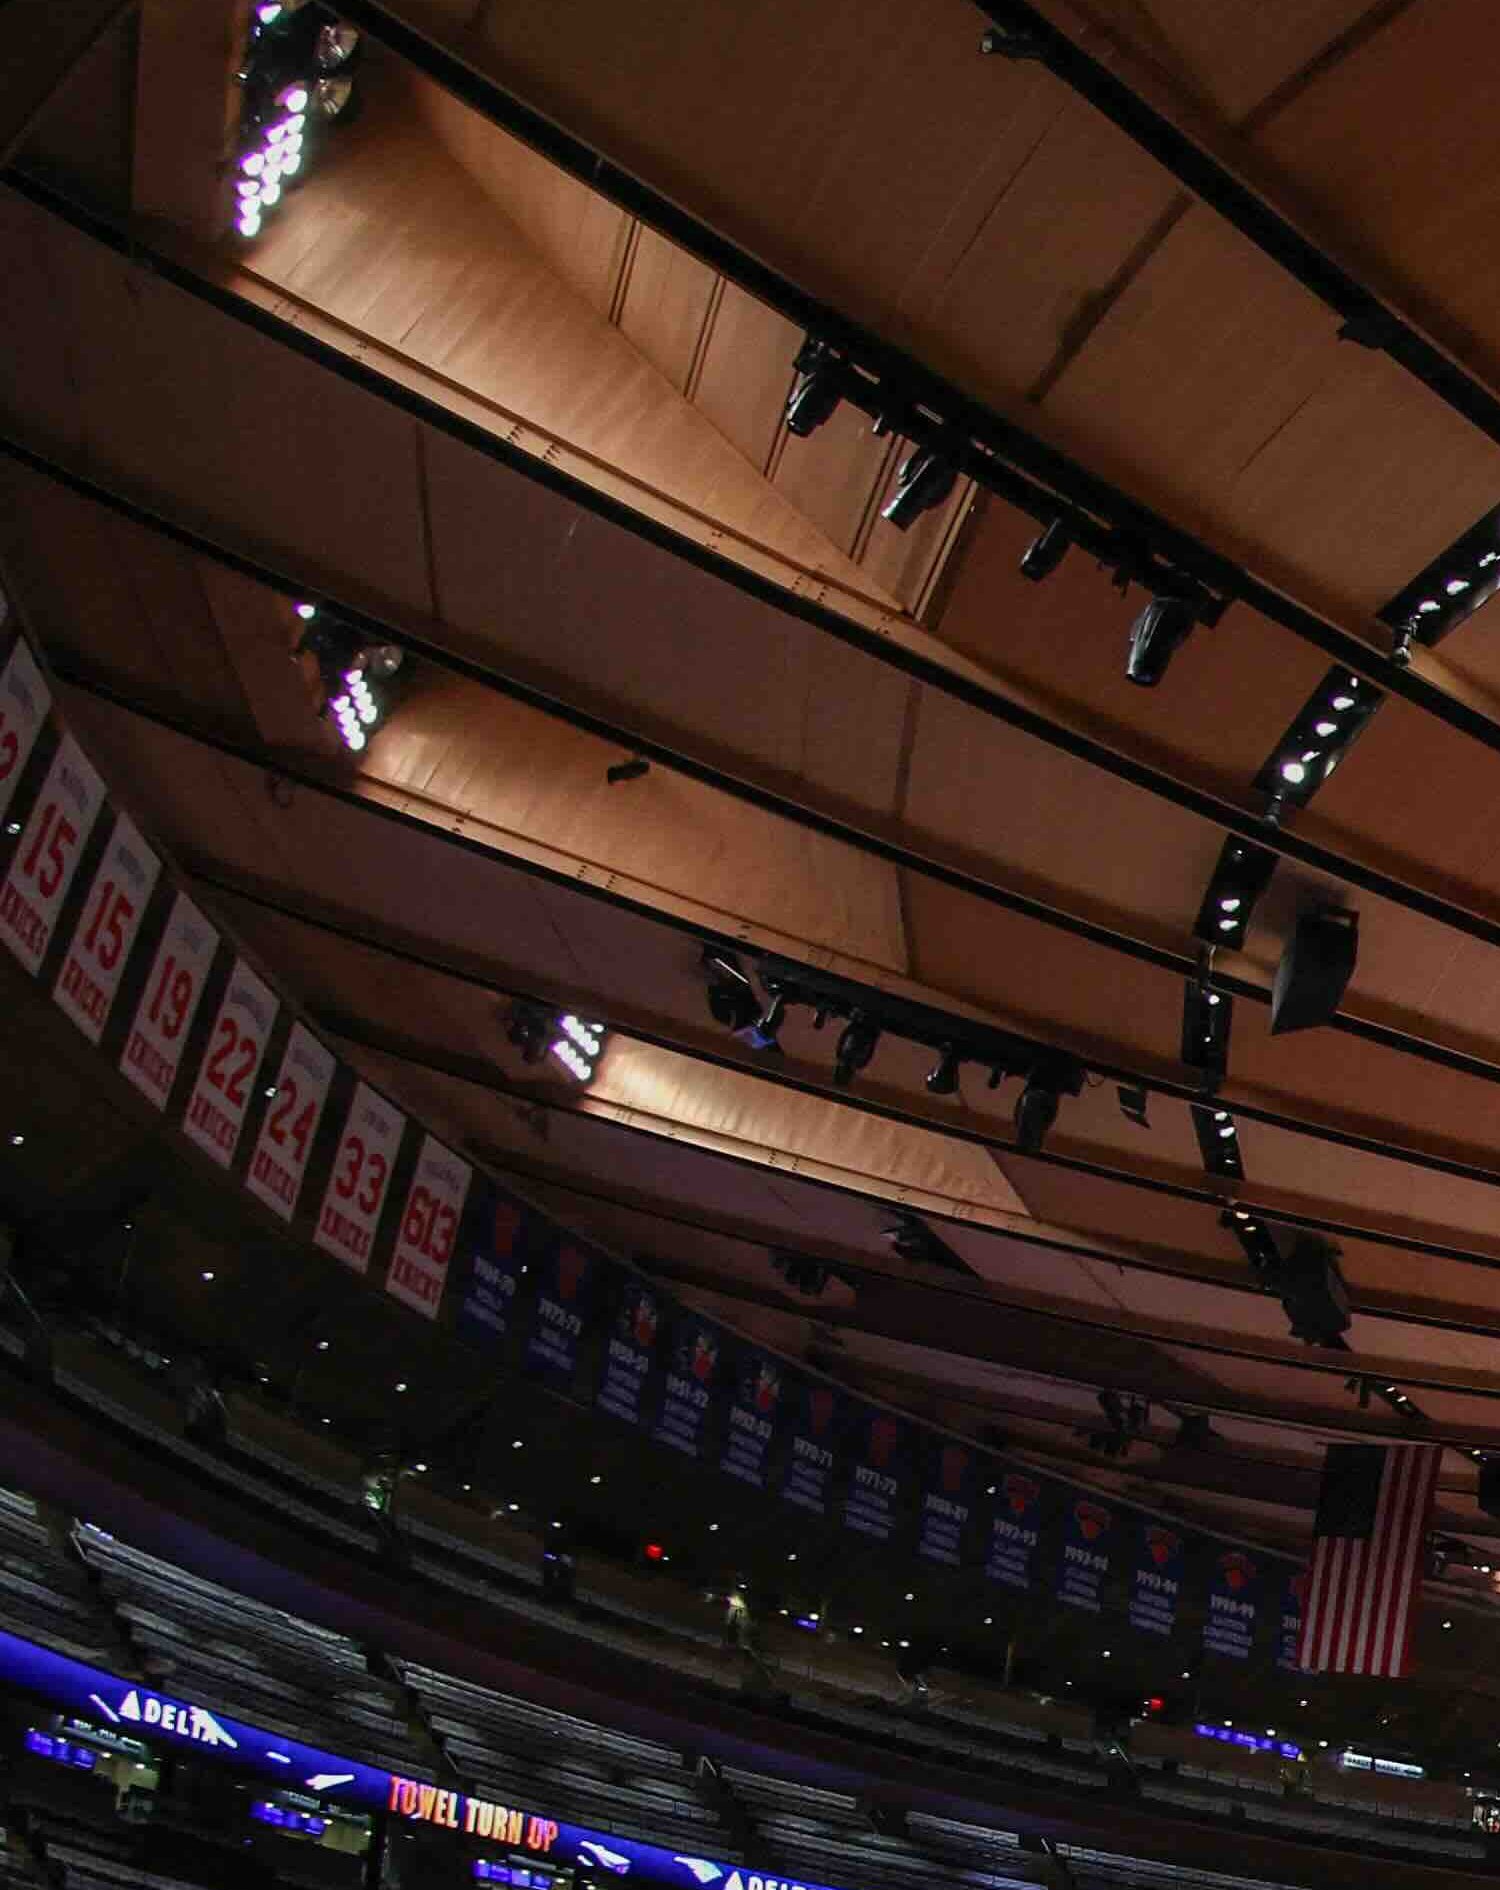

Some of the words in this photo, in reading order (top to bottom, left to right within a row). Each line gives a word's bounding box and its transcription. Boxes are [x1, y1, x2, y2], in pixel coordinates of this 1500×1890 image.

[24, 803, 78, 897] 15
[86, 882, 134, 970] 15
[150, 956, 192, 1037] 19
[207, 1019, 257, 1105] 22
[270, 1078, 315, 1161] 24
[336, 1137, 388, 1214] 33
[404, 1186, 457, 1264] 613
[388, 1775, 460, 1829] TOWEL
[464, 1798, 523, 1845] TURN
[526, 1816, 559, 1852] UP
